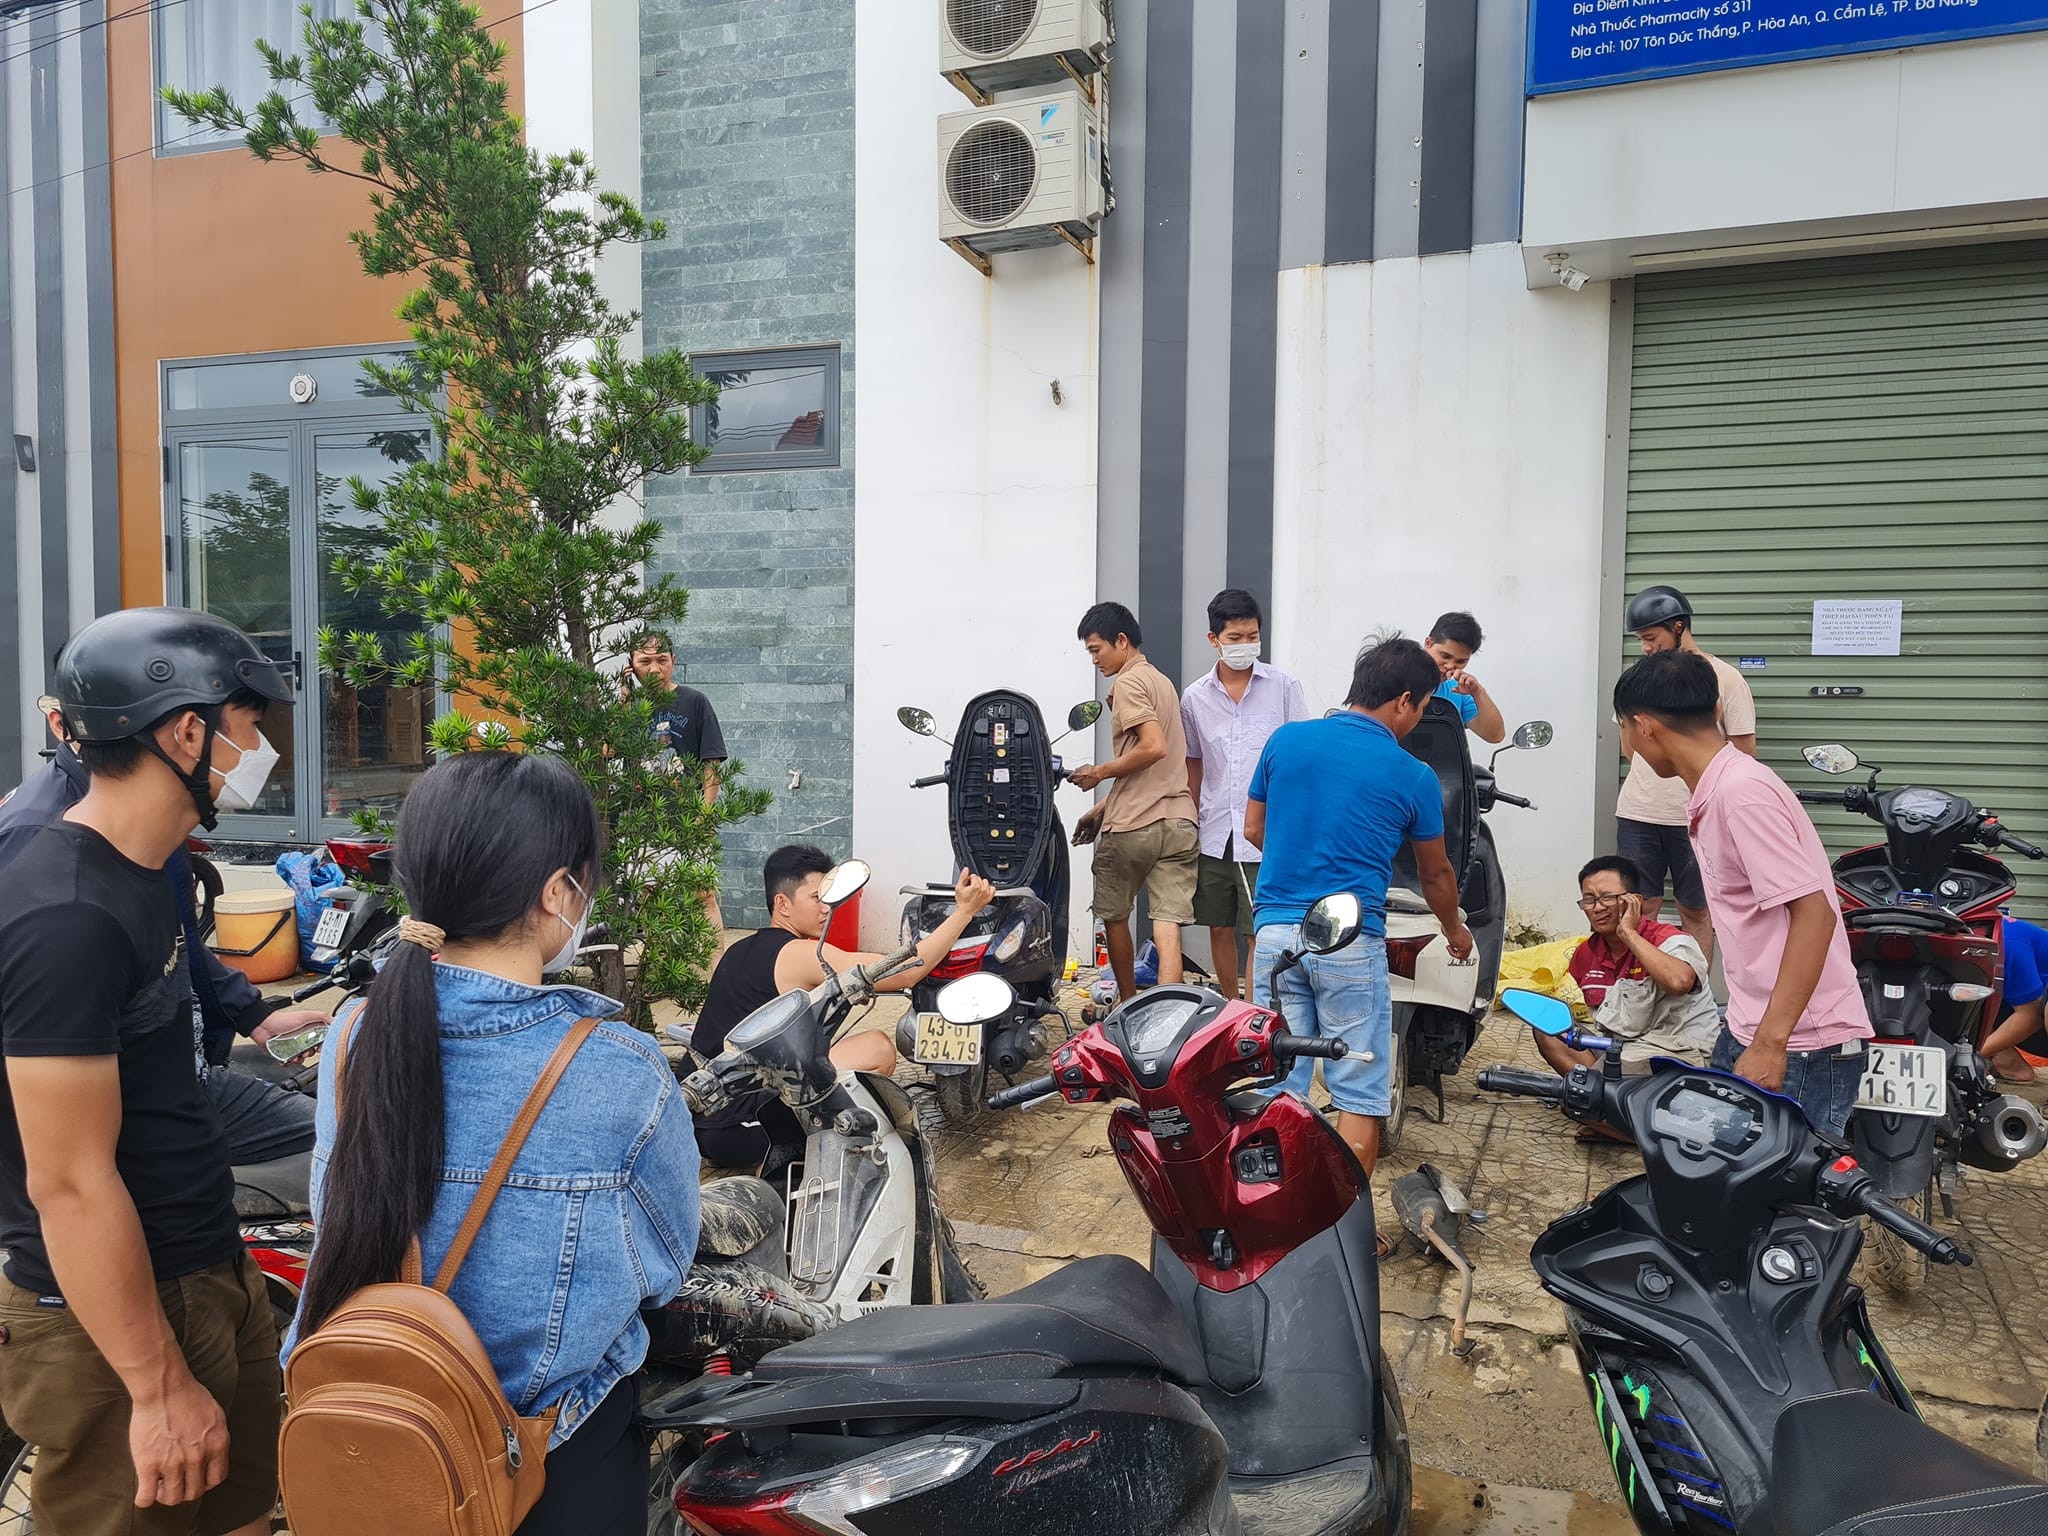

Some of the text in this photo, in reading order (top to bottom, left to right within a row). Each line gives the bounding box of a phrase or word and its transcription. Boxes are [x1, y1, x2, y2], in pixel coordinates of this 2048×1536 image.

[1571, 0, 1751, 37] Nhà Thuốc Pharmacity số 311
[1573, 2, 1593, 15] Địa
[1571, 46, 1592, 59] Địa
[1595, 41, 1616, 55] chỉ:
[1620, 38, 1640, 51] 107
[1643, 36, 1665, 48] Tôn
[1669, 31, 1694, 44] Đức
[1697, 24, 1741, 40] Thắng,
[1743, 21, 1754, 33] P.
[1758, 18, 1785, 31] Hòa
[1789, 14, 1811, 26] An,
[1815, 11, 1830, 22] Q.
[1834, 4, 1866, 20] Cẩm
[1892, 0, 1912, 12] TP.
[919, 1039, 977, 1061] 234.79
